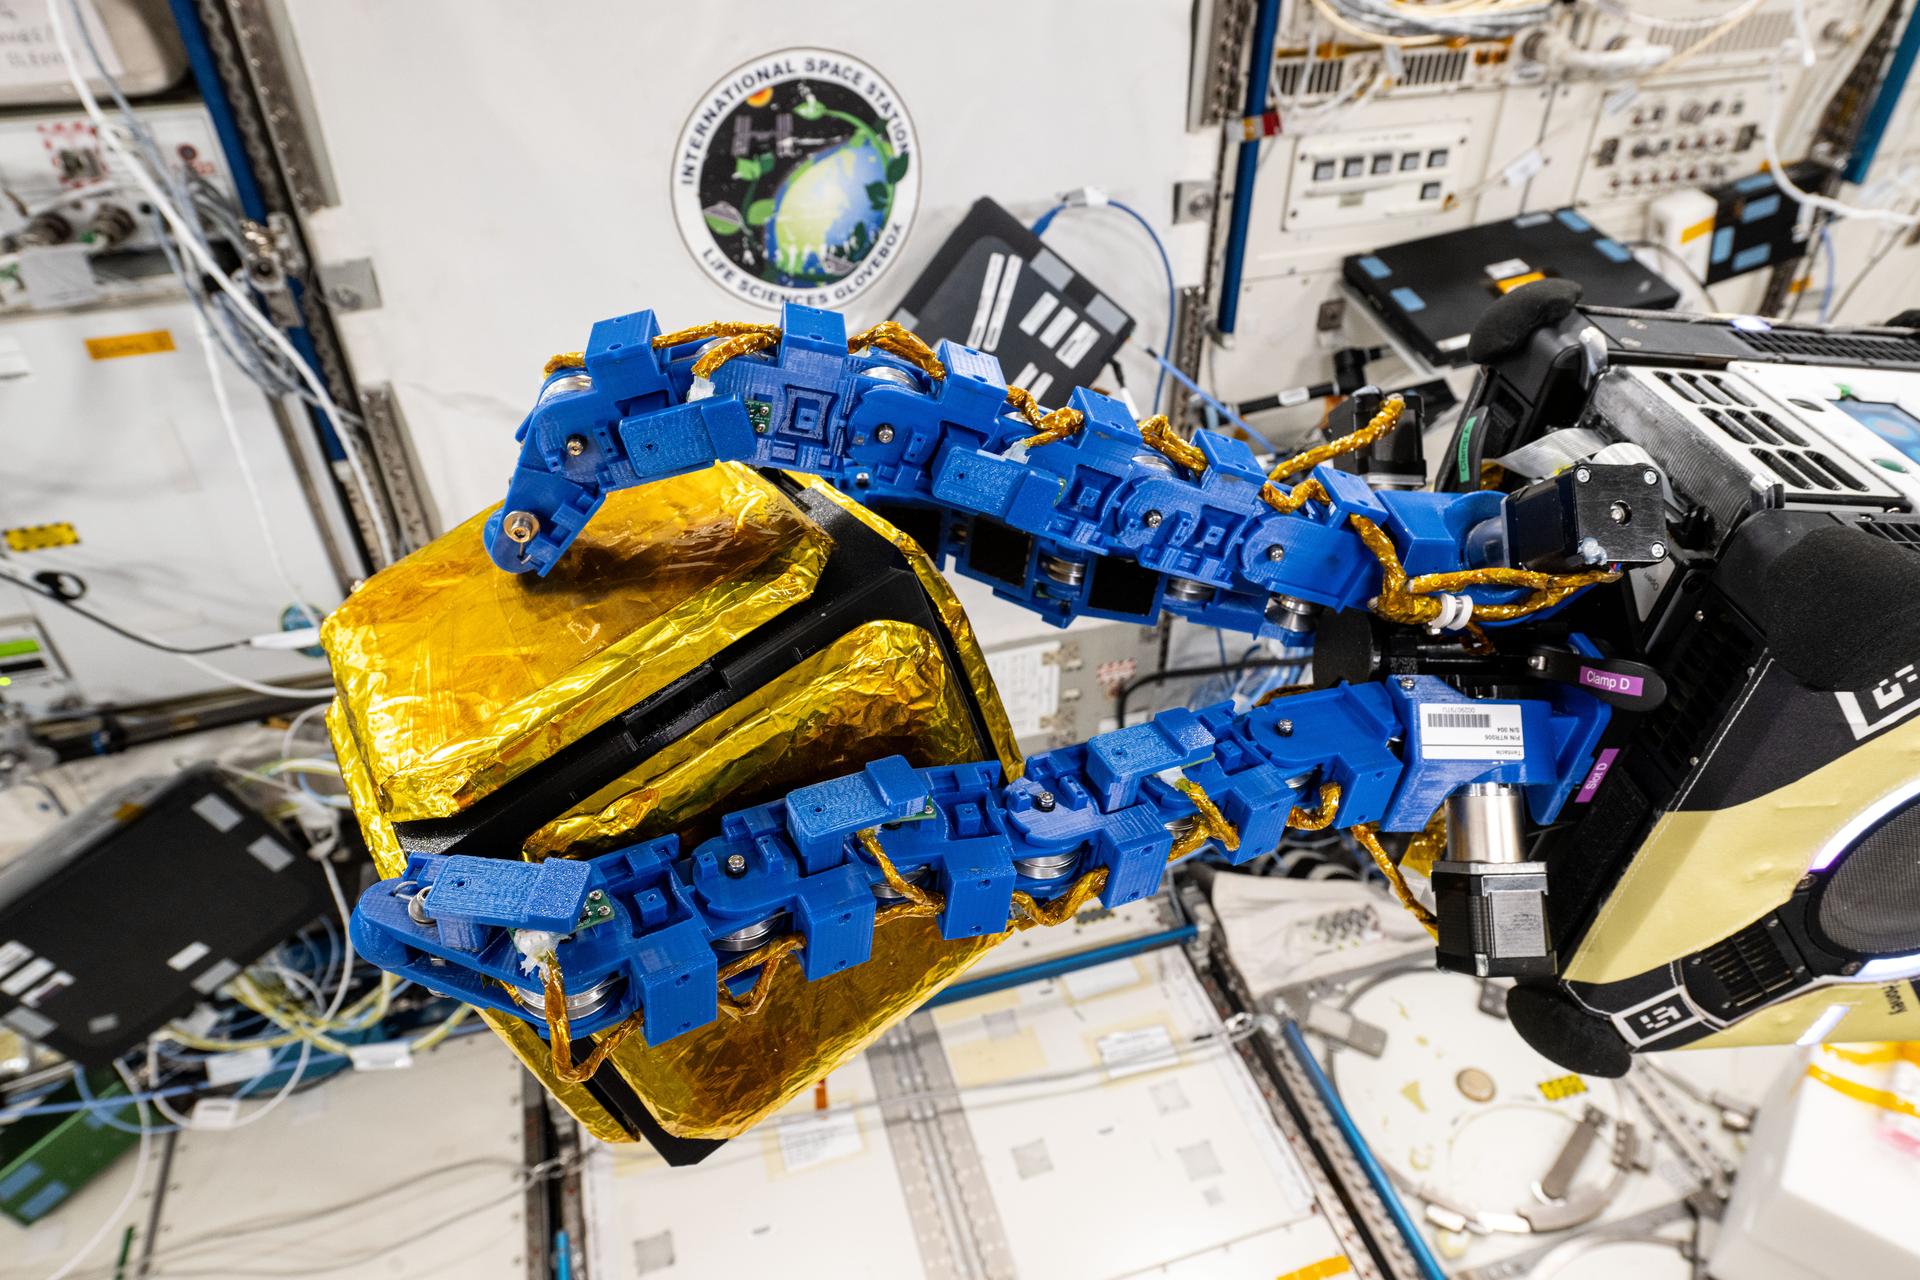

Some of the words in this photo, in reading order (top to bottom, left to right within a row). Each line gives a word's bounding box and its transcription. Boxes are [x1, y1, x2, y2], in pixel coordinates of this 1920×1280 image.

[682, 60, 796, 184] INTERNATIONAL
[804, 58, 864, 85] SPACE
[703, 247, 736, 282] LIFE
[834, 223, 902, 299] GLOVEBOX
[1586, 670, 1617, 690] Clamp
[1619, 677, 1630, 690] D
[1585, 771, 1603, 790] Slot
[1596, 762, 1608, 771] D
